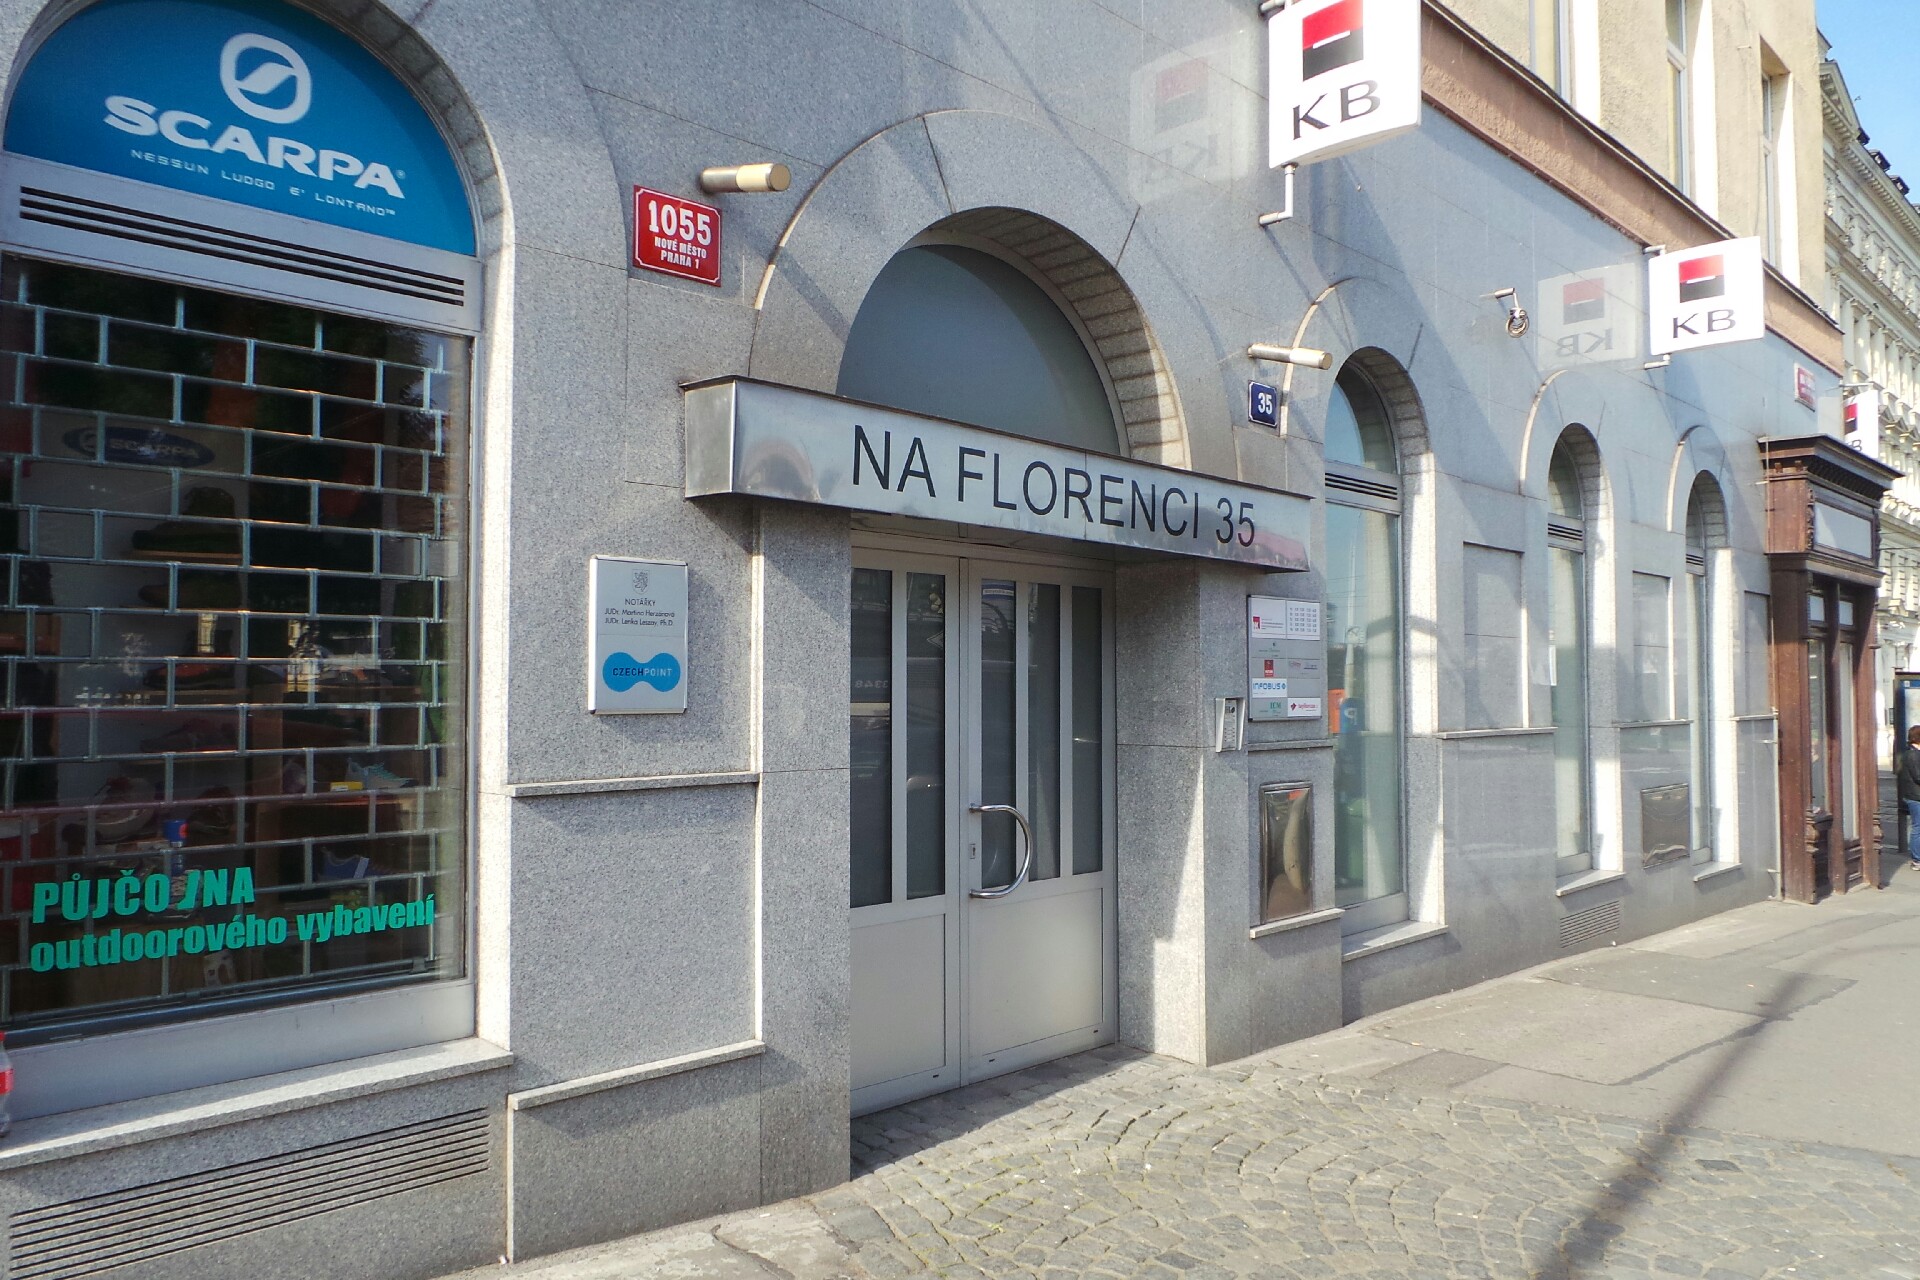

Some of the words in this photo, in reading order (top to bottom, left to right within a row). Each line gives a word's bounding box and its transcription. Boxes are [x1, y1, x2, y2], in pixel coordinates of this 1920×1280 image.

[1293, 80, 1381, 140] KB
[131, 149, 209, 175] NESSUN
[221, 170, 275, 190] LUOGO
[648, 200, 711, 246] 1055
[654, 236, 677, 251] NOVÉ
[679, 242, 707, 259] MĚSTO
[661, 249, 692, 267] PRAHA
[694, 259, 699, 269] 1
[1672, 309, 1736, 339] KB
[1257, 392, 1273, 415] 35
[852, 424, 936, 498] NA
[958, 446, 1199, 539] FLORENCI
[1215, 497, 1255, 548] 35
[30, 913, 288, 972] outdoorového
[296, 893, 435, 944] vybavení
